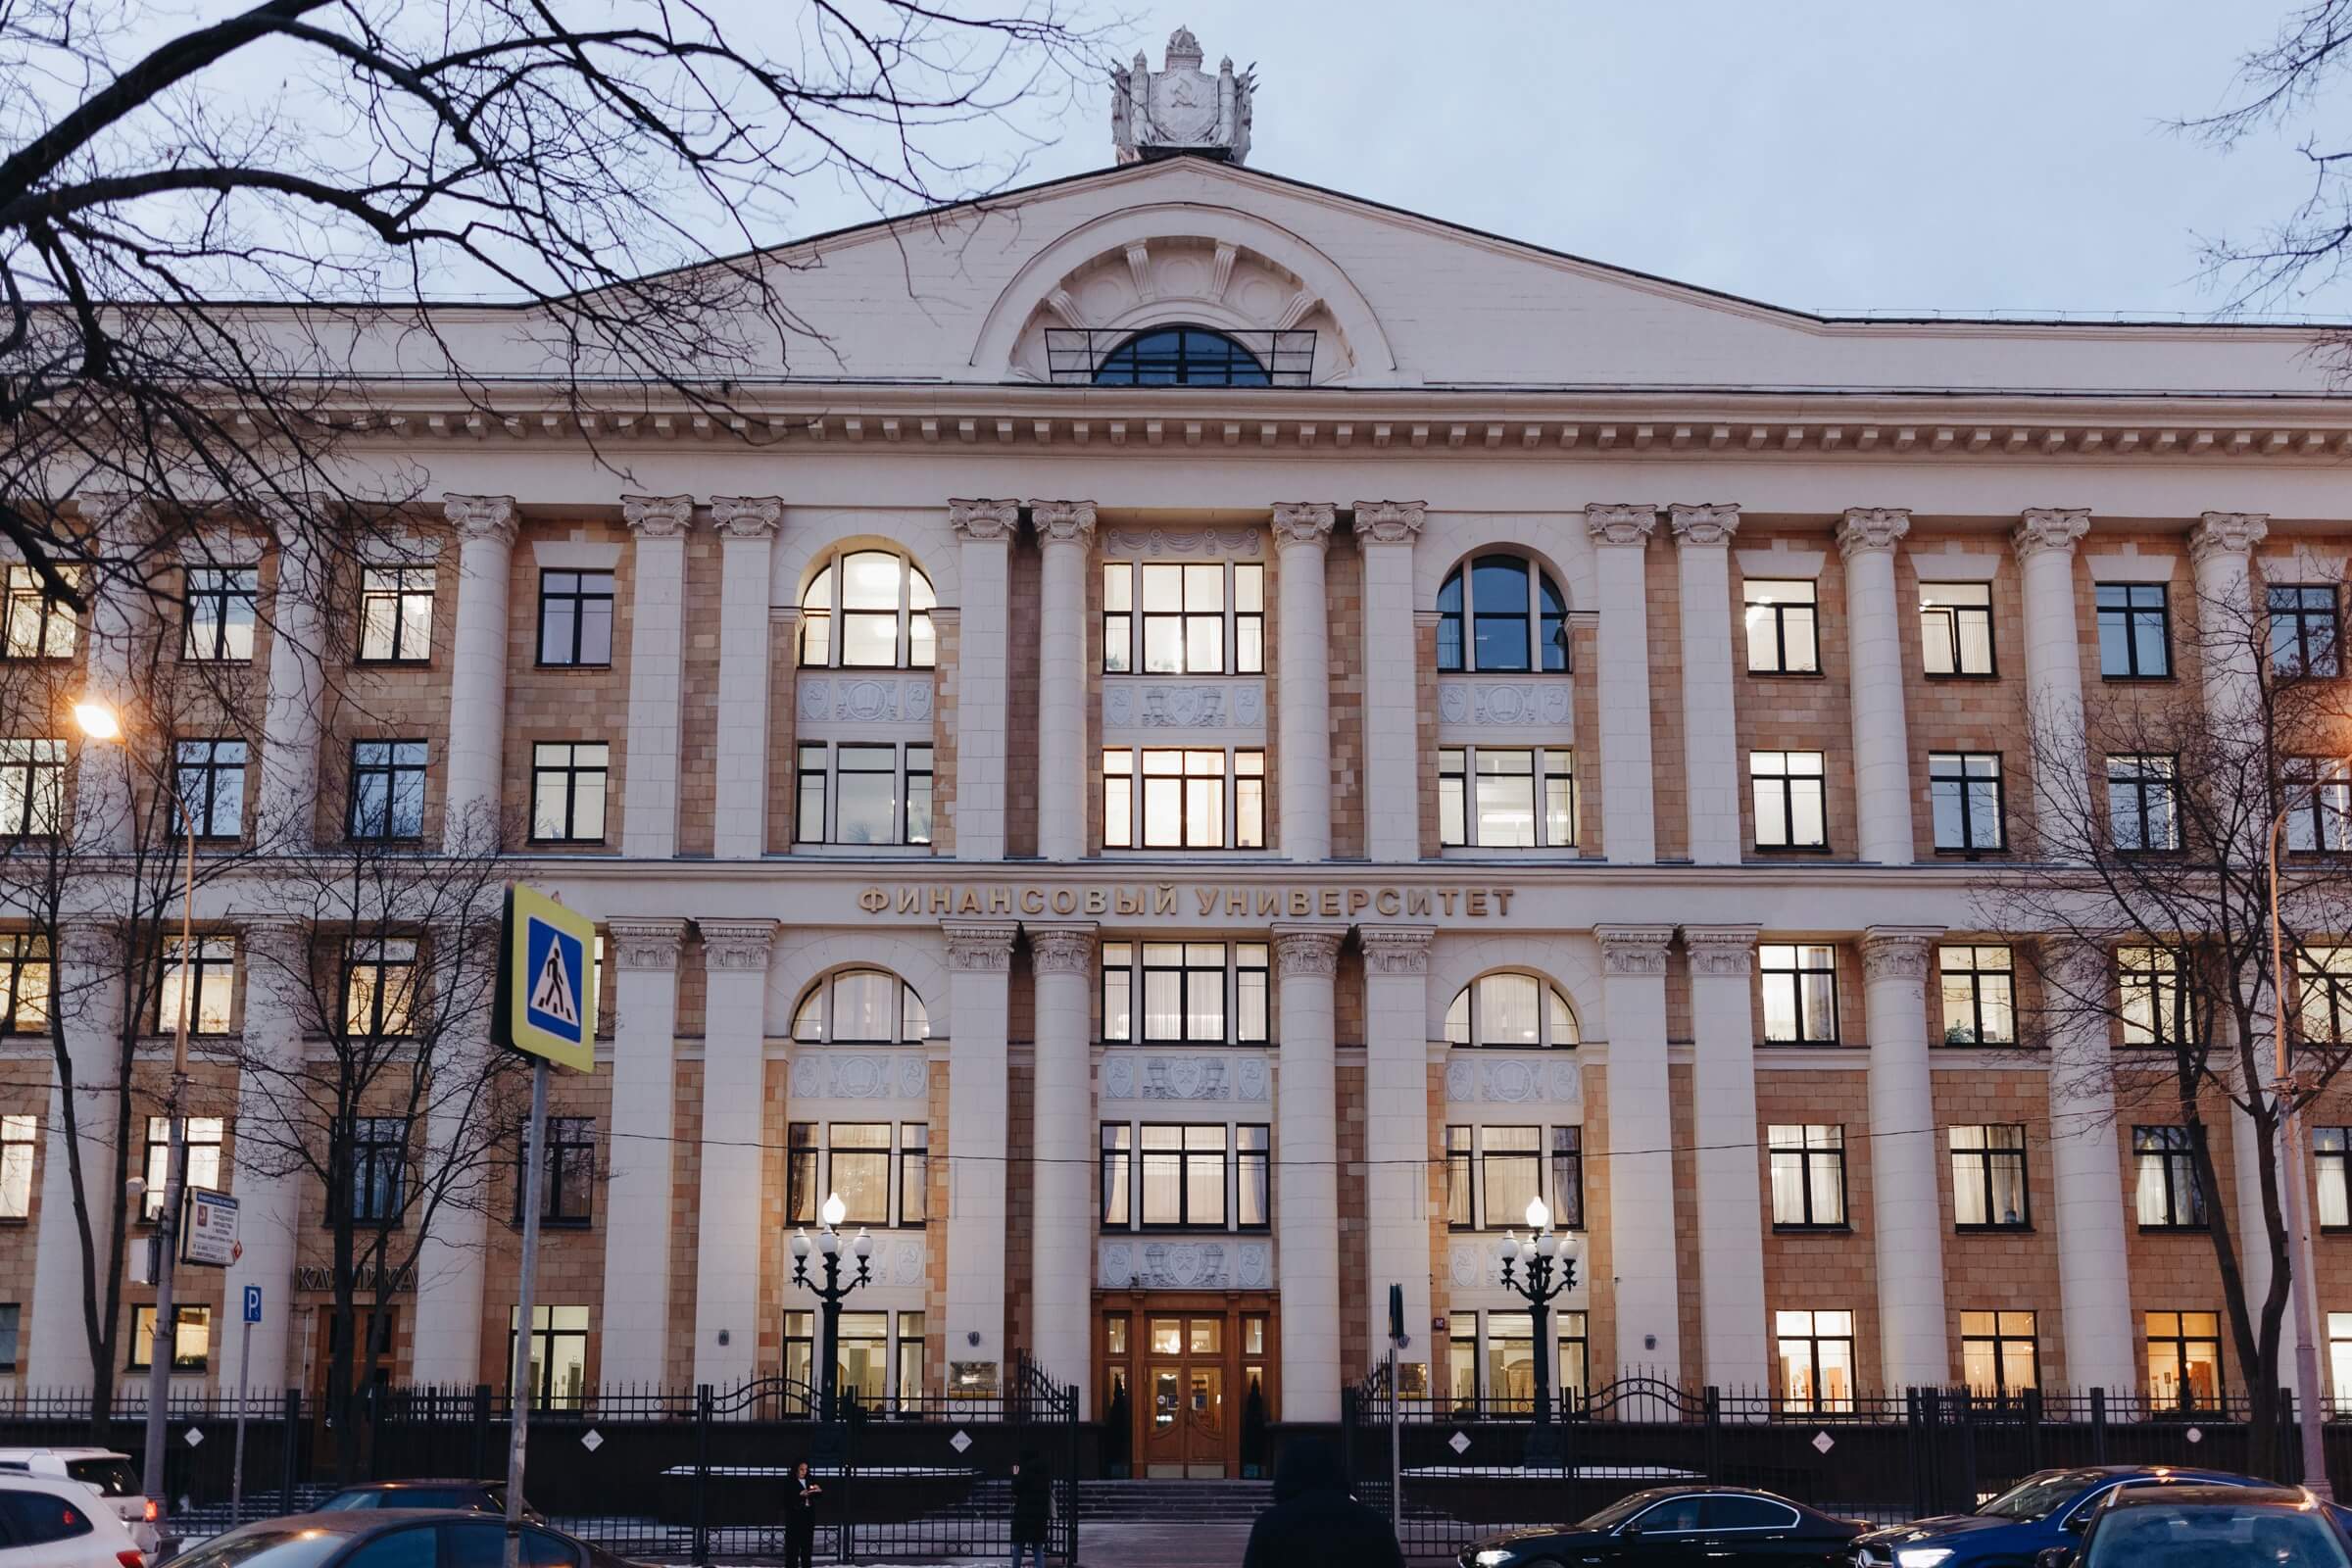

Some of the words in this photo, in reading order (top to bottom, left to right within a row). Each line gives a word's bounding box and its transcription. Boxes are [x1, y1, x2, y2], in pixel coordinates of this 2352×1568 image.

[858, 883, 1177, 914] ФИНАНСОВЫЙ
[1196, 888, 1514, 915] УНИВЕРСИТЕТ
[248, 1290, 259, 1318] P
